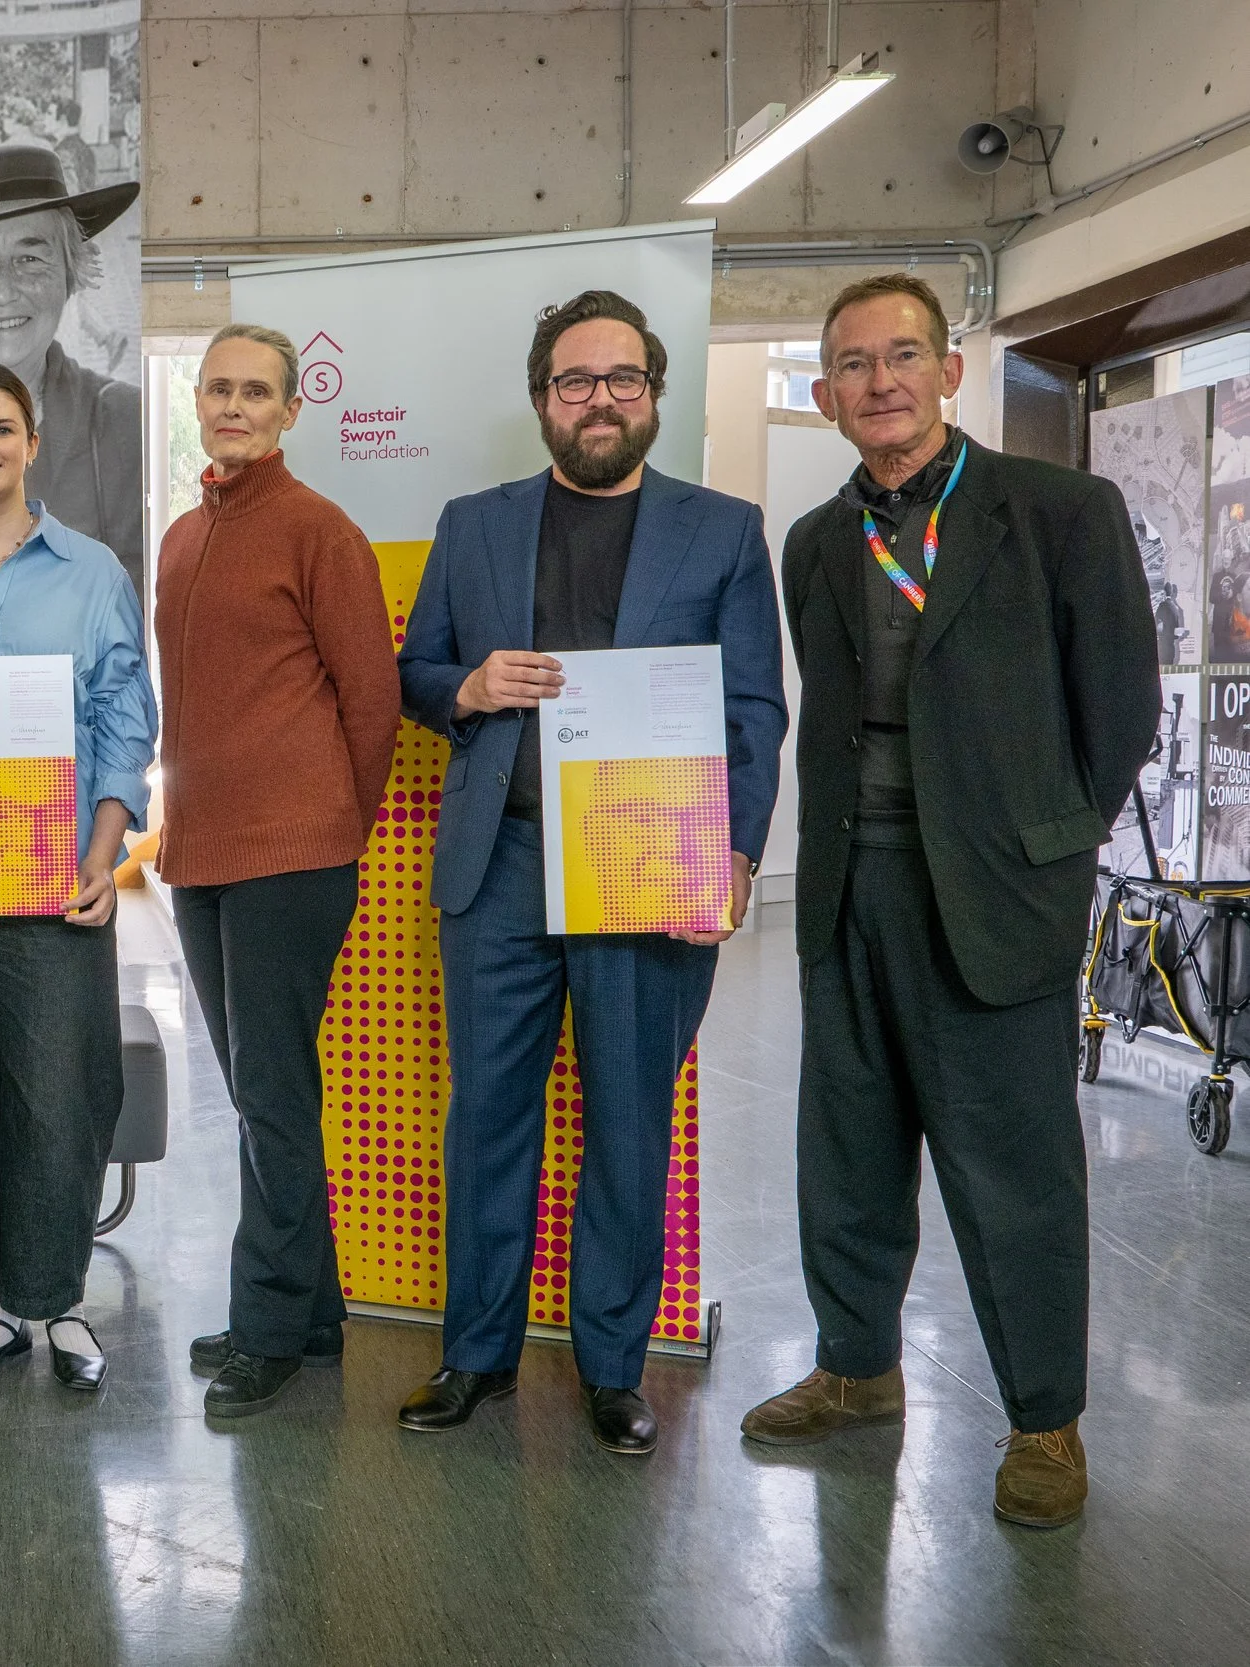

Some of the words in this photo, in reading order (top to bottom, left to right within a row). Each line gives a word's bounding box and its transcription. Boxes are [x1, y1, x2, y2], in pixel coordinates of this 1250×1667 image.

[315, 371, 328, 392] S
[340, 406, 406, 424] Alastair
[340, 428, 396, 445] Swayn
[341, 444, 429, 461] Foundation
[1210, 682, 1216, 721] I
